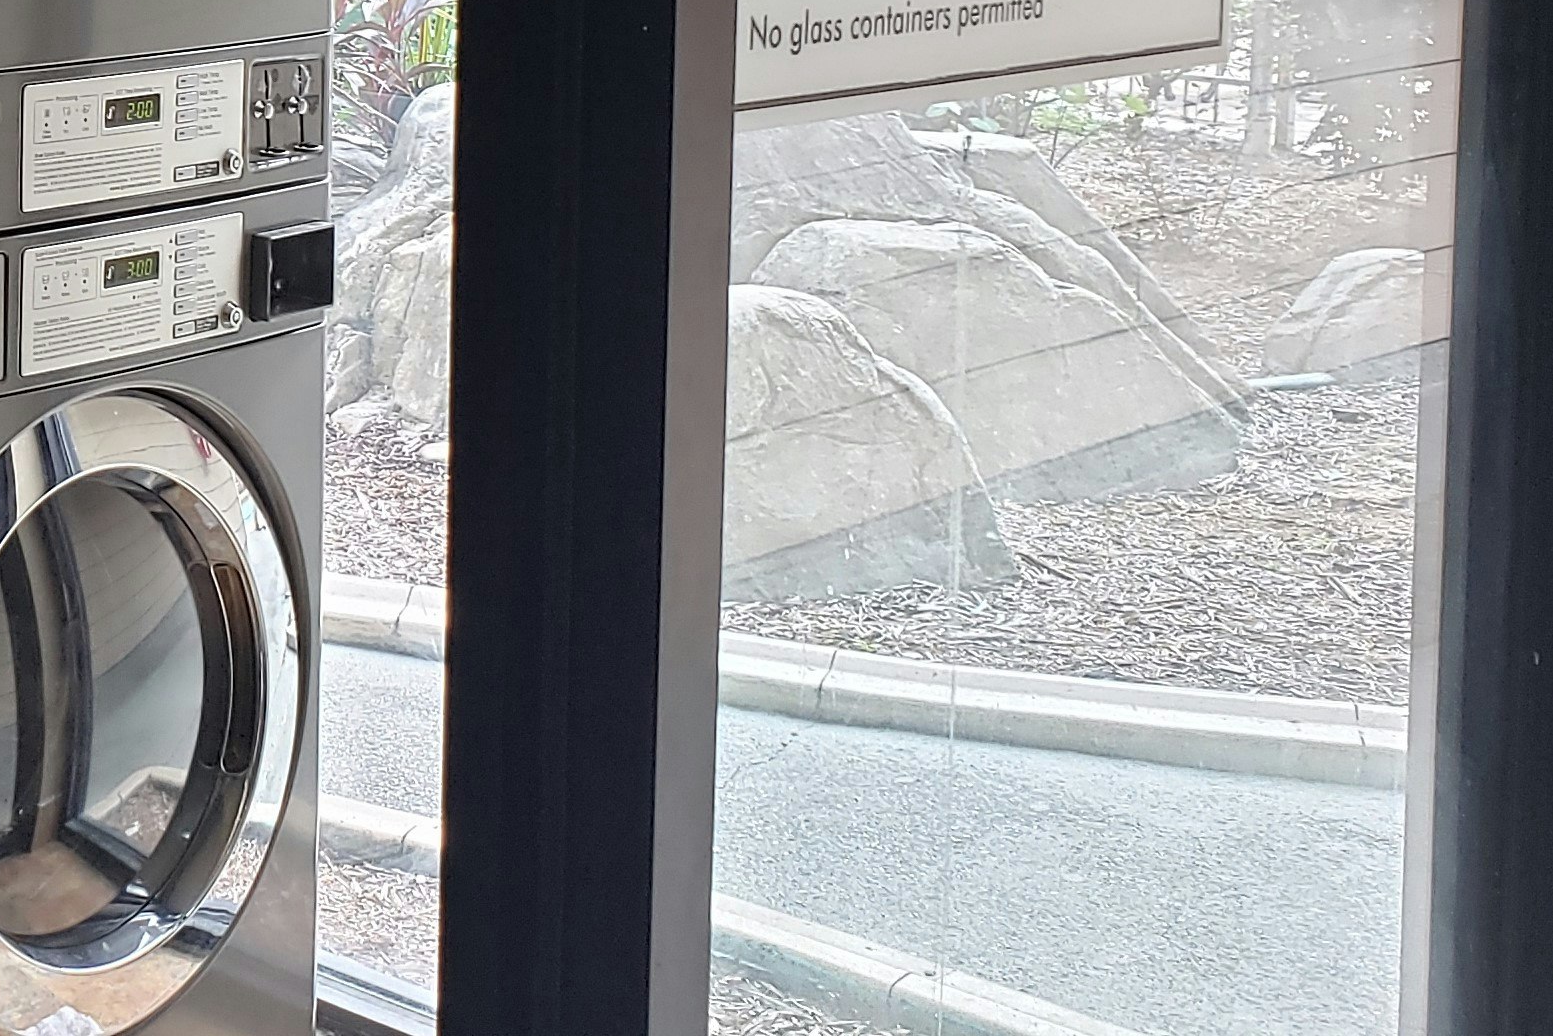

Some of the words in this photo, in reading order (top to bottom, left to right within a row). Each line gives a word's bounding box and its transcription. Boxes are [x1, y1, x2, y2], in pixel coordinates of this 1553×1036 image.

[749, 15, 782, 50] No
[790, 10, 842, 55] glass
[850, 1, 950, 40] containers
